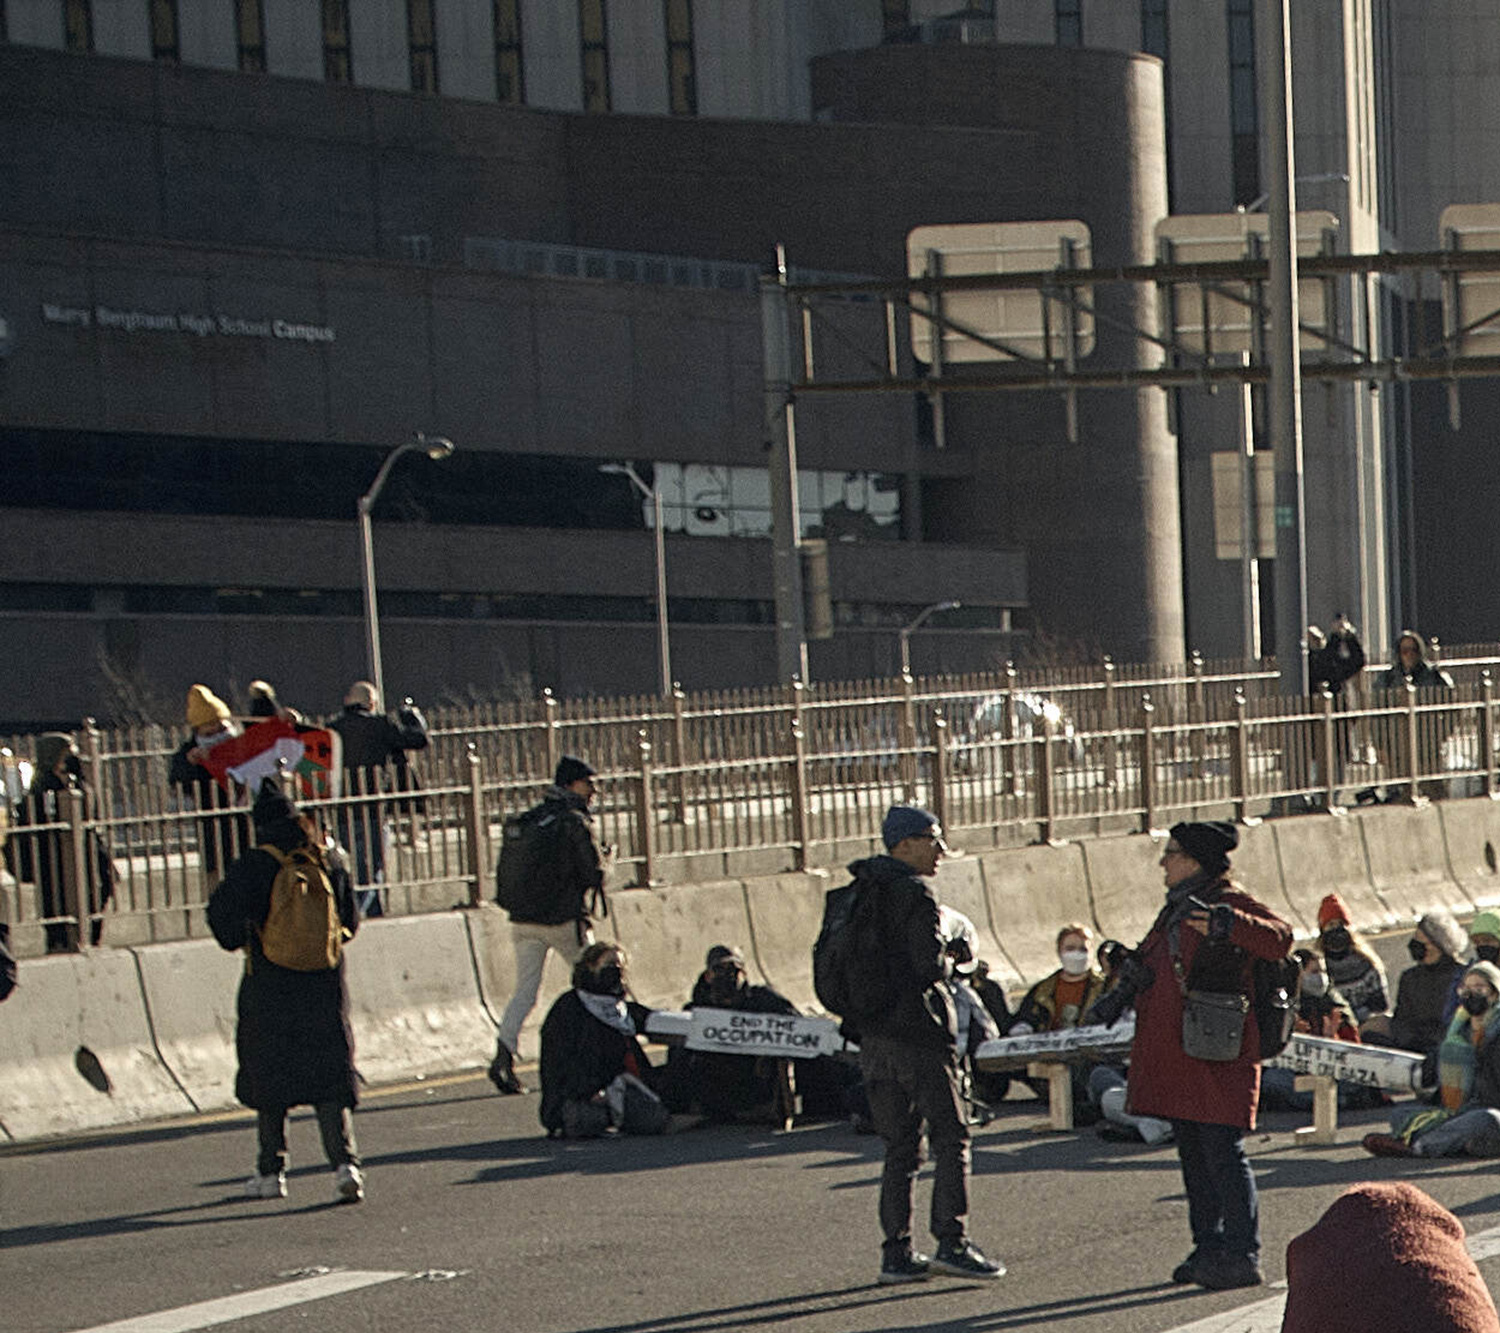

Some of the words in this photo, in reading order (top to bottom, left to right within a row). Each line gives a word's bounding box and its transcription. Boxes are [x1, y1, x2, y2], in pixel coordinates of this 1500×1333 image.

[272, 319, 336, 341] Campus
[730, 1016, 762, 1028] END
[767, 1018, 796, 1031] THE
[703, 1027, 820, 1047] OCCUPATION
[1340, 1066, 1379, 1086] GAZA
